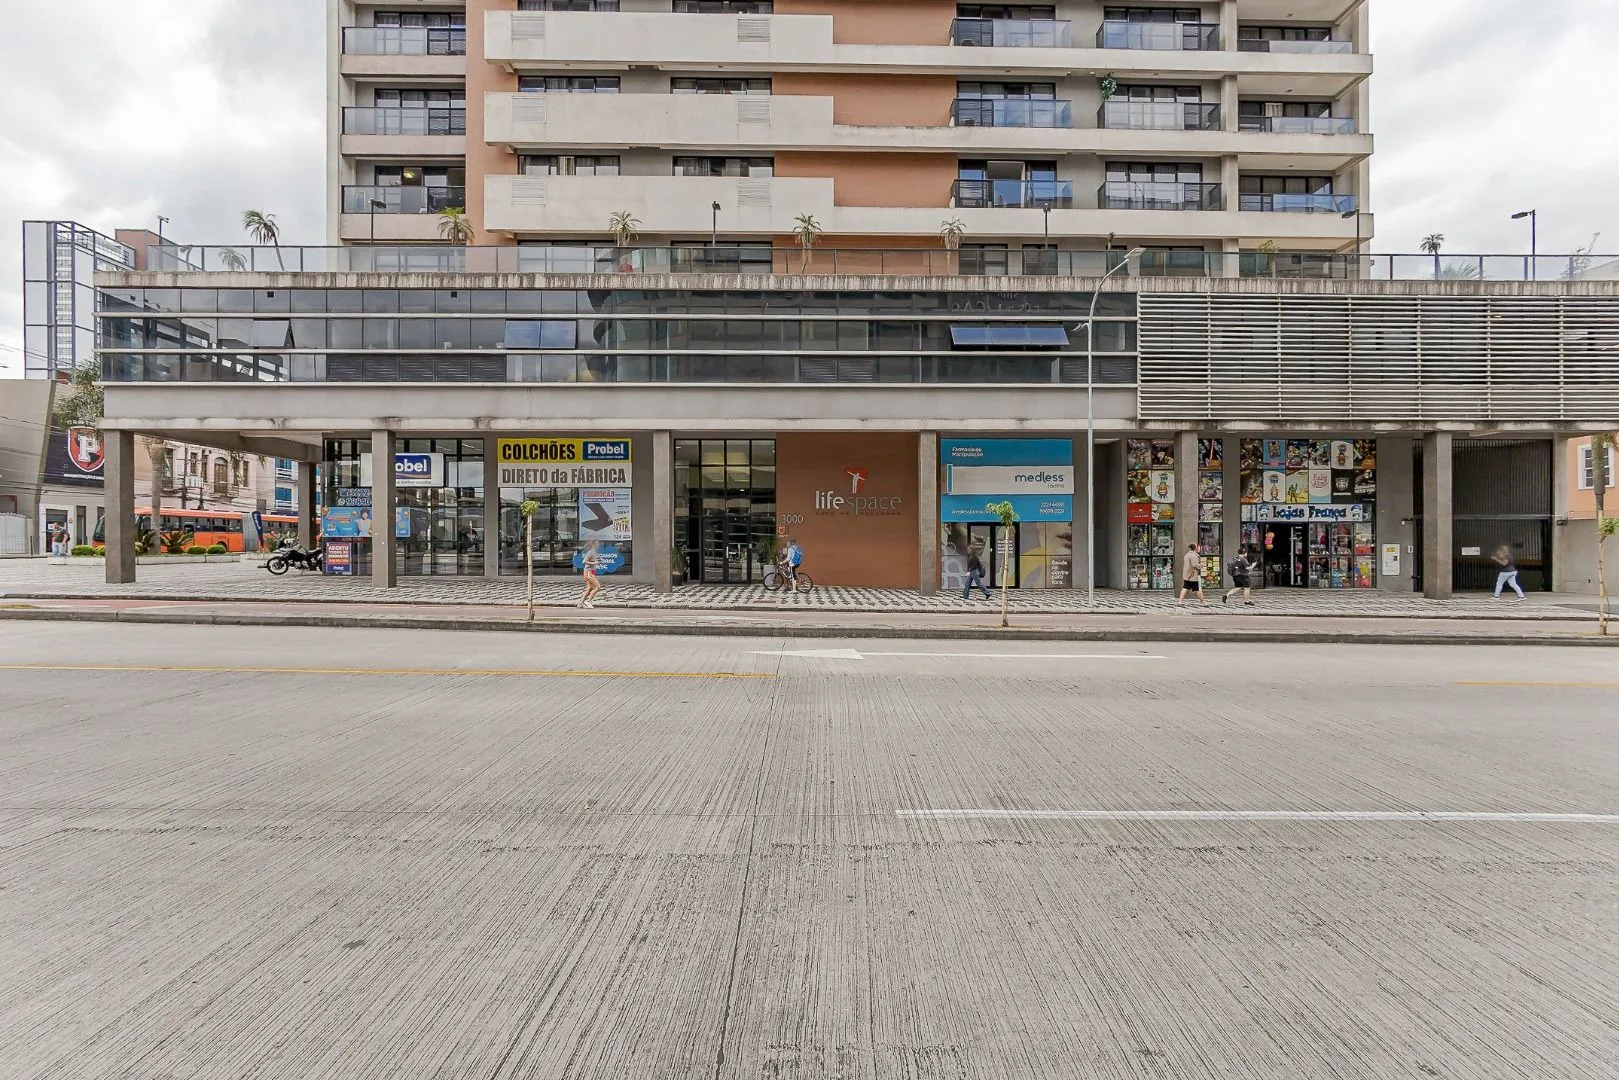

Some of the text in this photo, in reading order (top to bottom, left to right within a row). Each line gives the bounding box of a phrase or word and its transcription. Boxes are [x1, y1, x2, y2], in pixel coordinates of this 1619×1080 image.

[502, 440, 624, 460] COLCHÕES Probel
[395, 459, 427, 472] obel
[502, 465, 627, 484] DIRETO da FÁBRICA
[1014, 471, 1064, 484] medless
[781, 514, 804, 524] 3000
[1272, 505, 1347, 521] Lojas França
